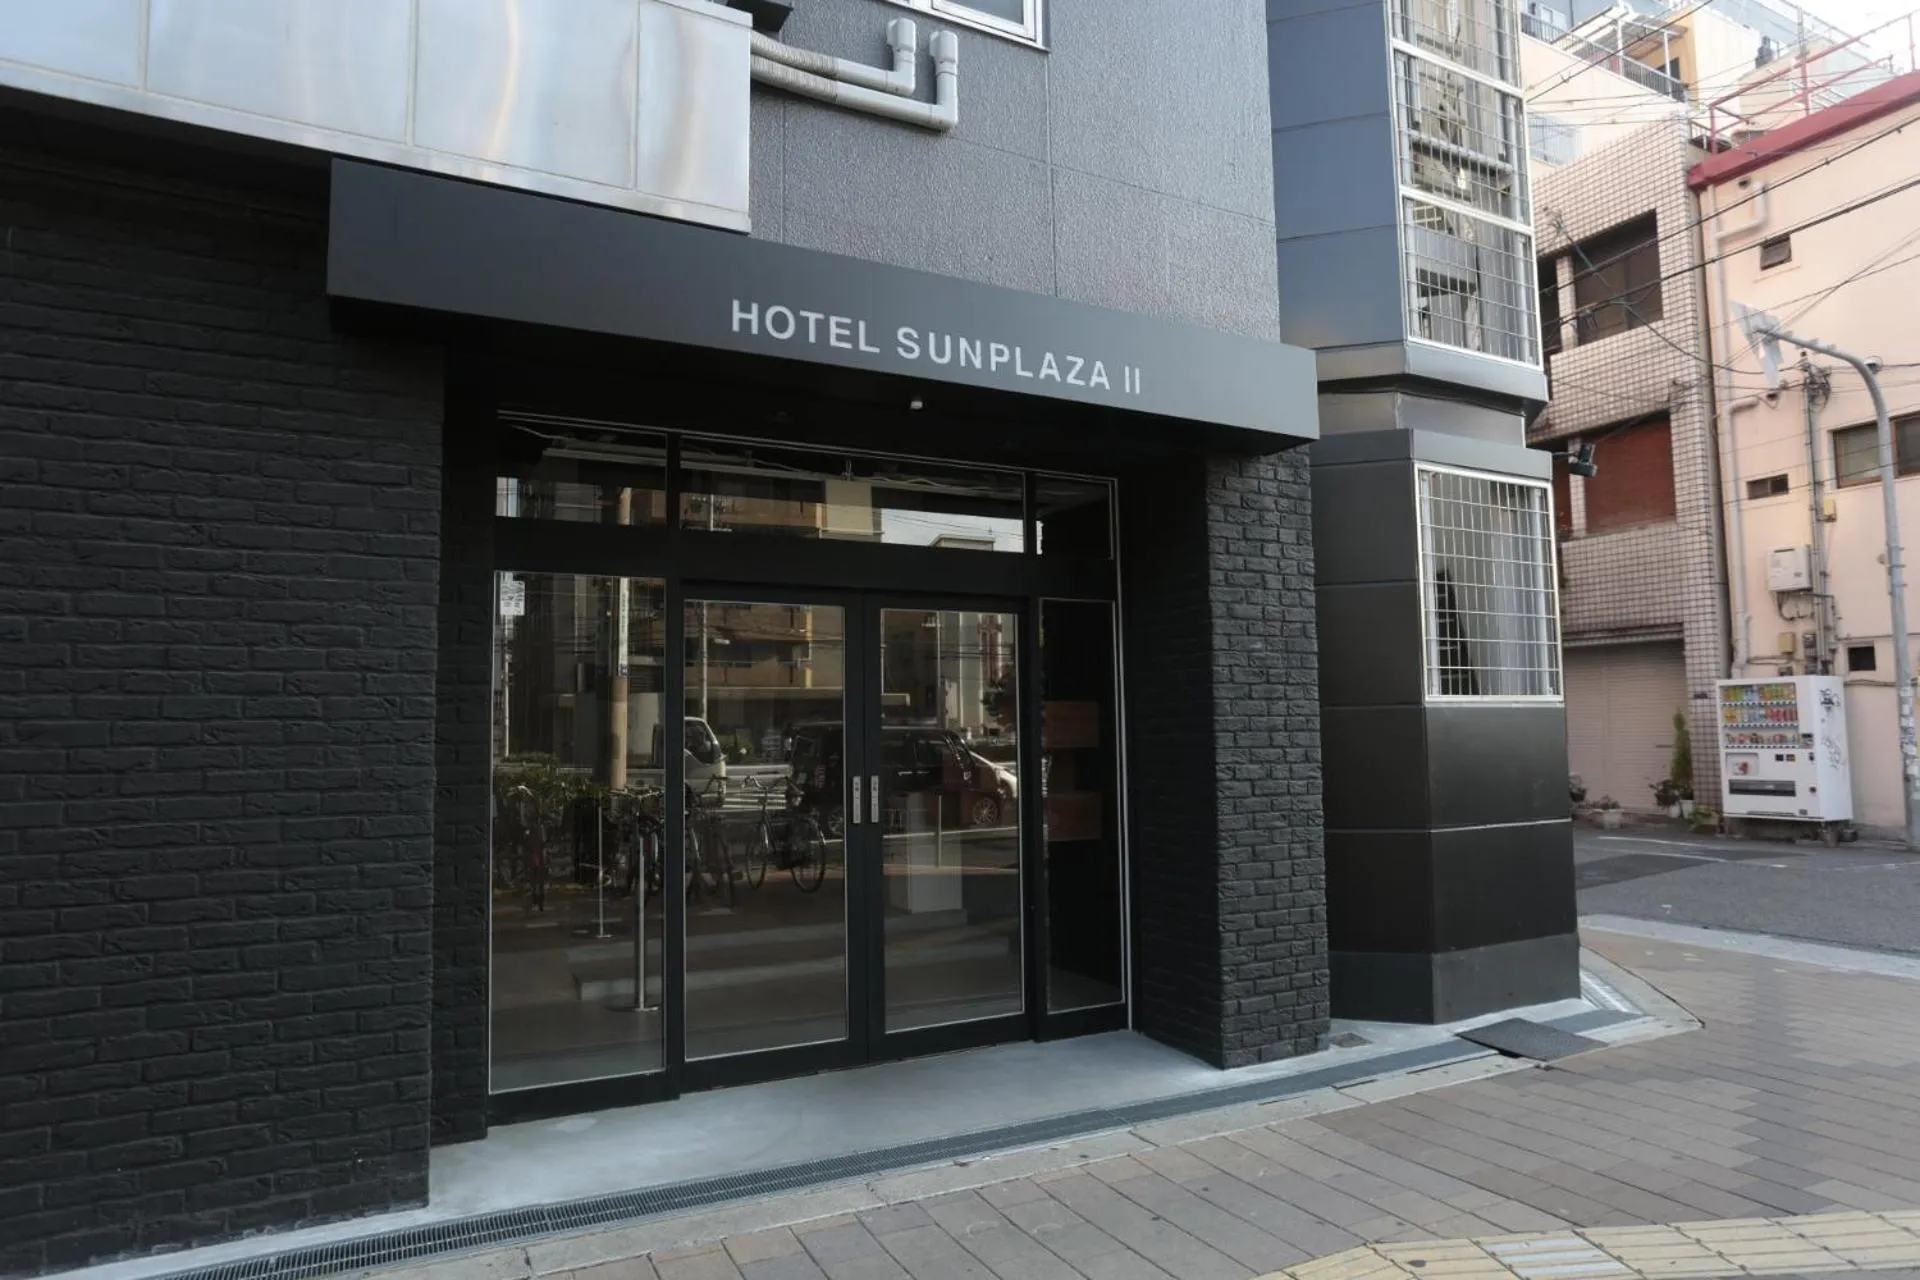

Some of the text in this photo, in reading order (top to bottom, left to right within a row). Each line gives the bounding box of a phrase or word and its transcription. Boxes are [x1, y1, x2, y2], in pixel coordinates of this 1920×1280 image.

[732, 299, 1142, 395] HOTEL SUNPLAZA II
